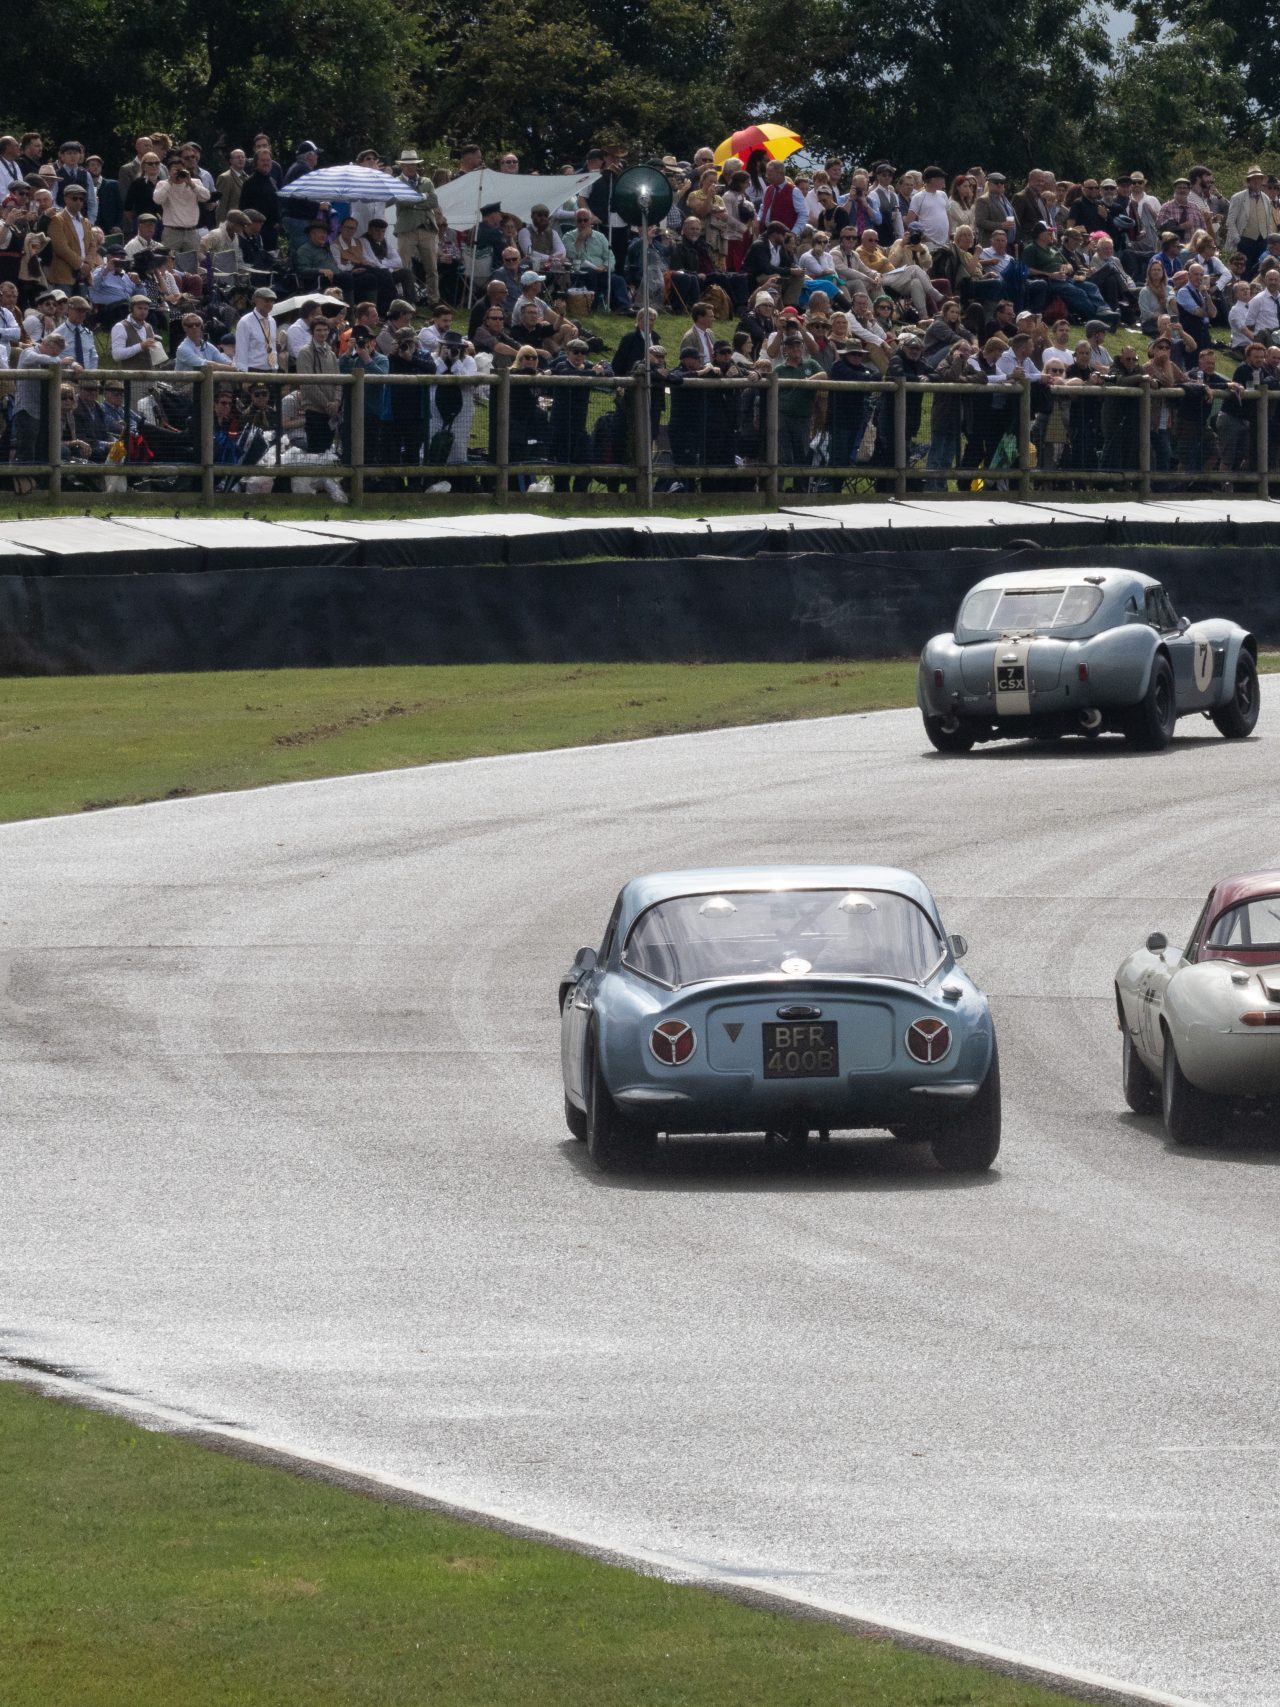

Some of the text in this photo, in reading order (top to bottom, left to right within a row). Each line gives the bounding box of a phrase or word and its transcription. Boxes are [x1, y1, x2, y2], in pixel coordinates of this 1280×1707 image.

[1007, 668, 1015, 679] 7
[999, 679, 1024, 689] CSX
[775, 1026, 825, 1048] BFR
[768, 1051, 833, 1072] 400B
